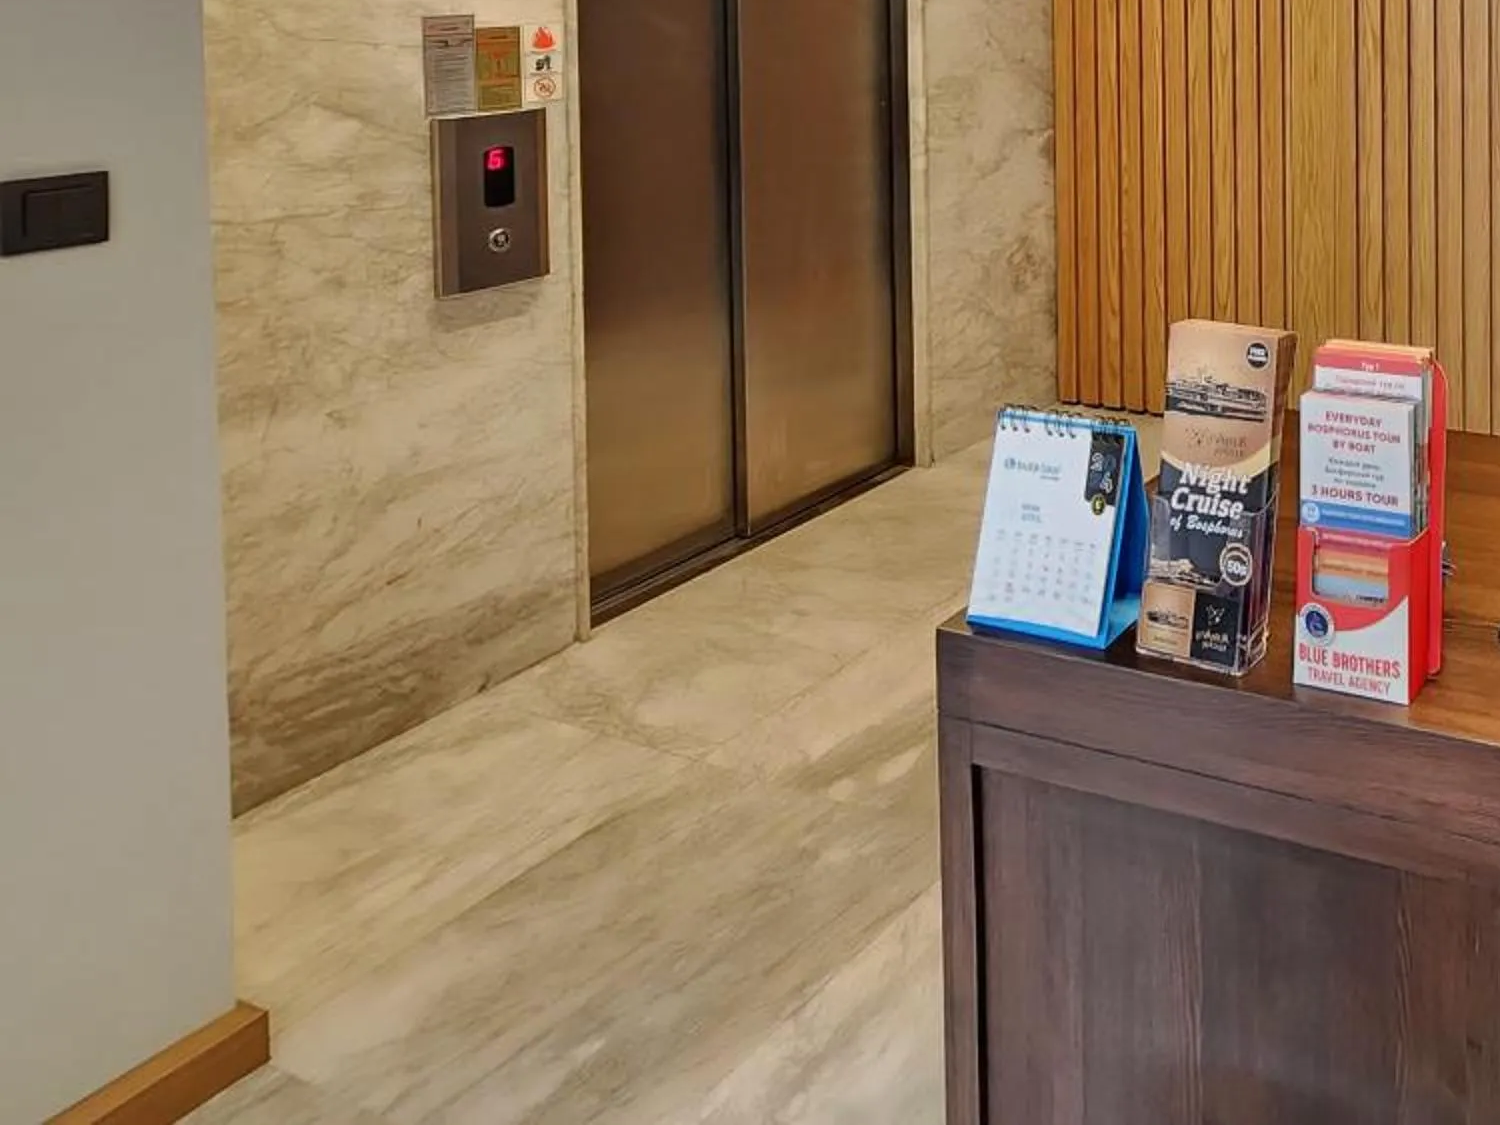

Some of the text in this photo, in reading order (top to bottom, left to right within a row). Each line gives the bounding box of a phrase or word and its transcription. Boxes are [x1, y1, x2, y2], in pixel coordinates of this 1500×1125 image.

[1325, 410, 1384, 428] EVERYDAY
[1307, 422, 1401, 444] BOSPHORUS TOUR
[1333, 439, 1377, 454] BY BOAT
[1179, 462, 1252, 495] Night
[1170, 486, 1244, 520] Cruise
[1320, 486, 1363, 502] HOURS
[1366, 492, 1399, 507] TOUR
[1169, 514, 1243, 538] of Bosphorus
[1299, 642, 1401, 679] BLUE BROTHERS
[1307, 665, 1392, 696] TRAVEL AGENCY
